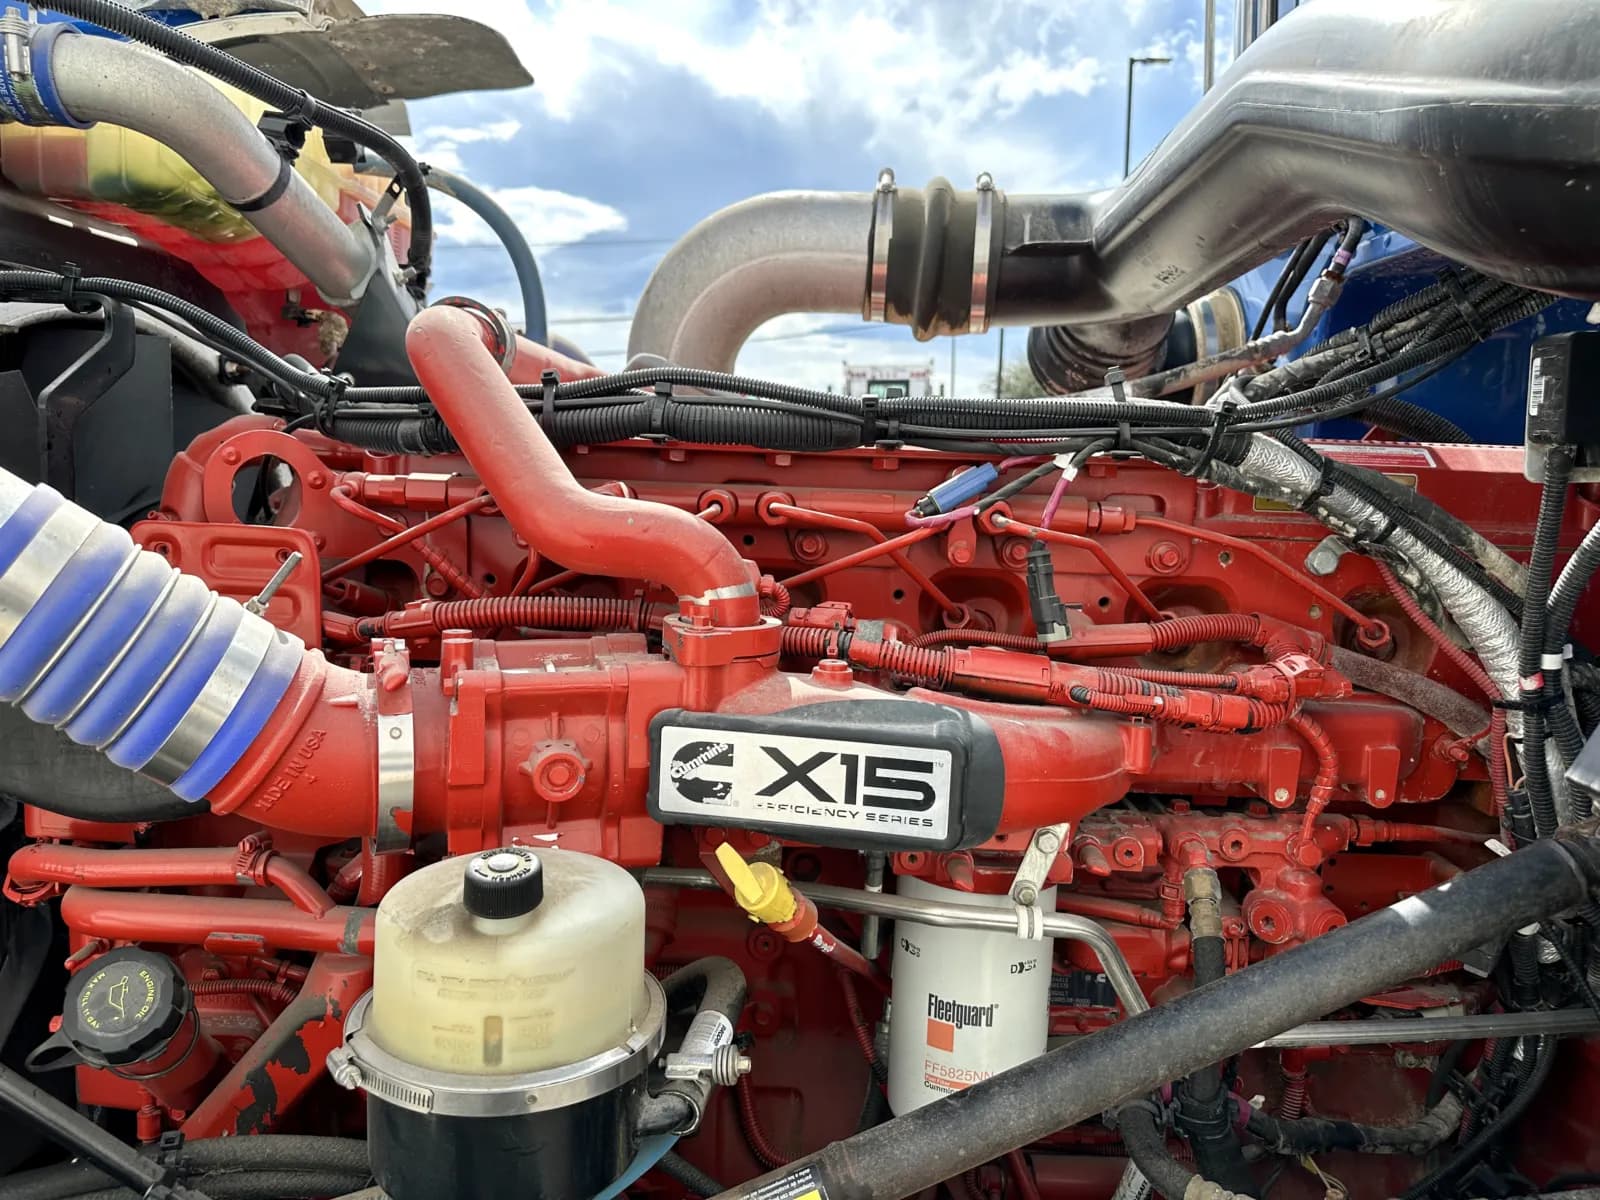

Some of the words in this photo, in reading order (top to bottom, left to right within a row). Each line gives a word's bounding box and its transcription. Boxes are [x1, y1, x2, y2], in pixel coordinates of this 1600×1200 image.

[298, 729, 327, 760] USA
[755, 745, 937, 812] X15
[753, 802, 859, 819] FFICIENCY
[866, 812, 933, 827] SERIES
[88, 972, 105, 989] MAX
[139, 970, 154, 1002] ENGINE
[135, 1005, 150, 1019] OIL
[928, 993, 994, 1029] Fleetguard
